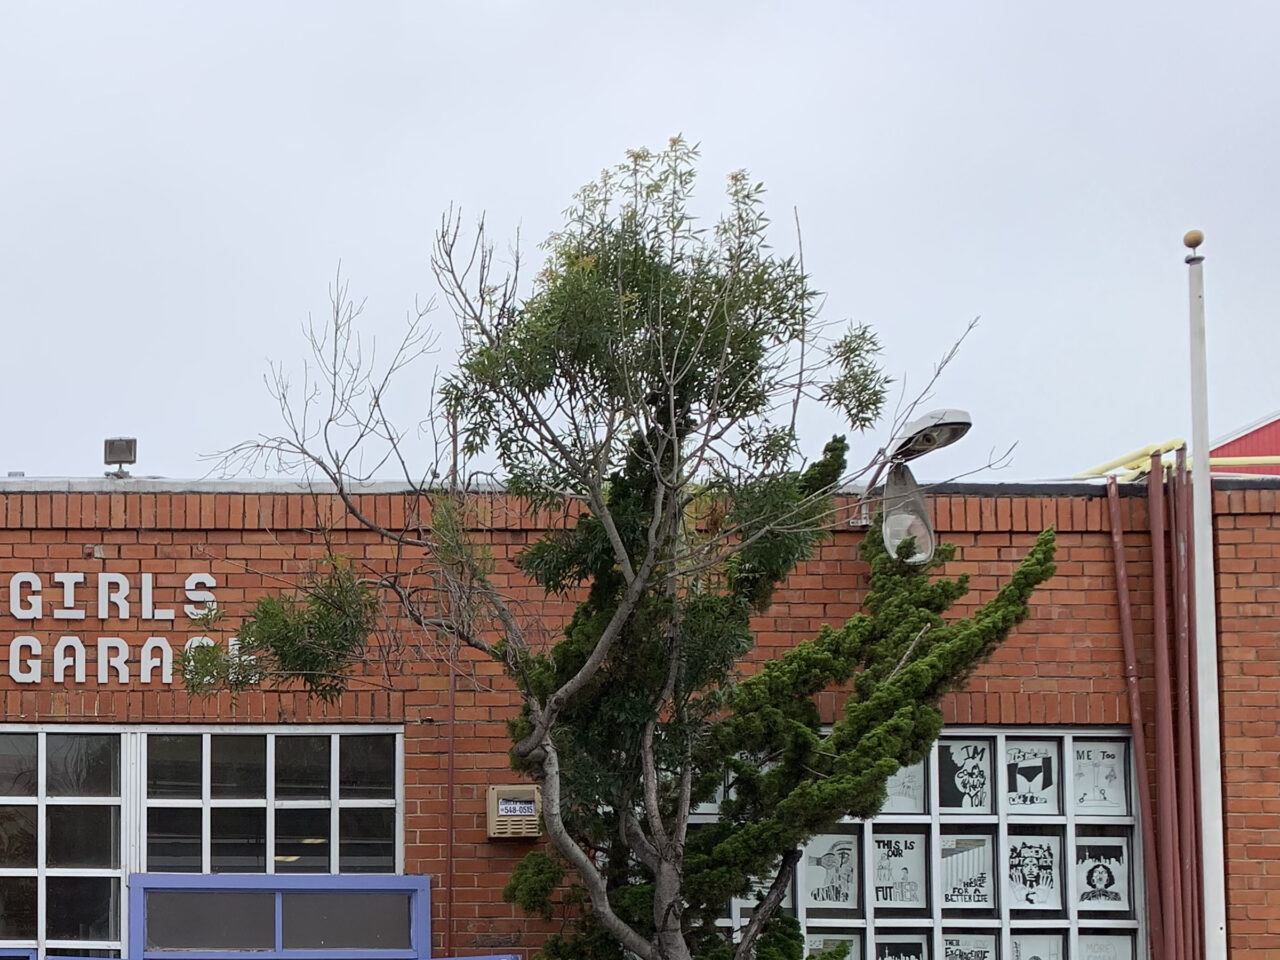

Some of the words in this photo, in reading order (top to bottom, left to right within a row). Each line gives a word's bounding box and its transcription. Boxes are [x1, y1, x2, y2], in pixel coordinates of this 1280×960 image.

[9, 572, 218, 620] GIRLS
[1076, 750, 1092, 761] ME
[875, 840, 901, 850] THIS
[904, 840, 916, 850] IS
[887, 849, 904, 858] OUR
[944, 894, 972, 903] BETTER
